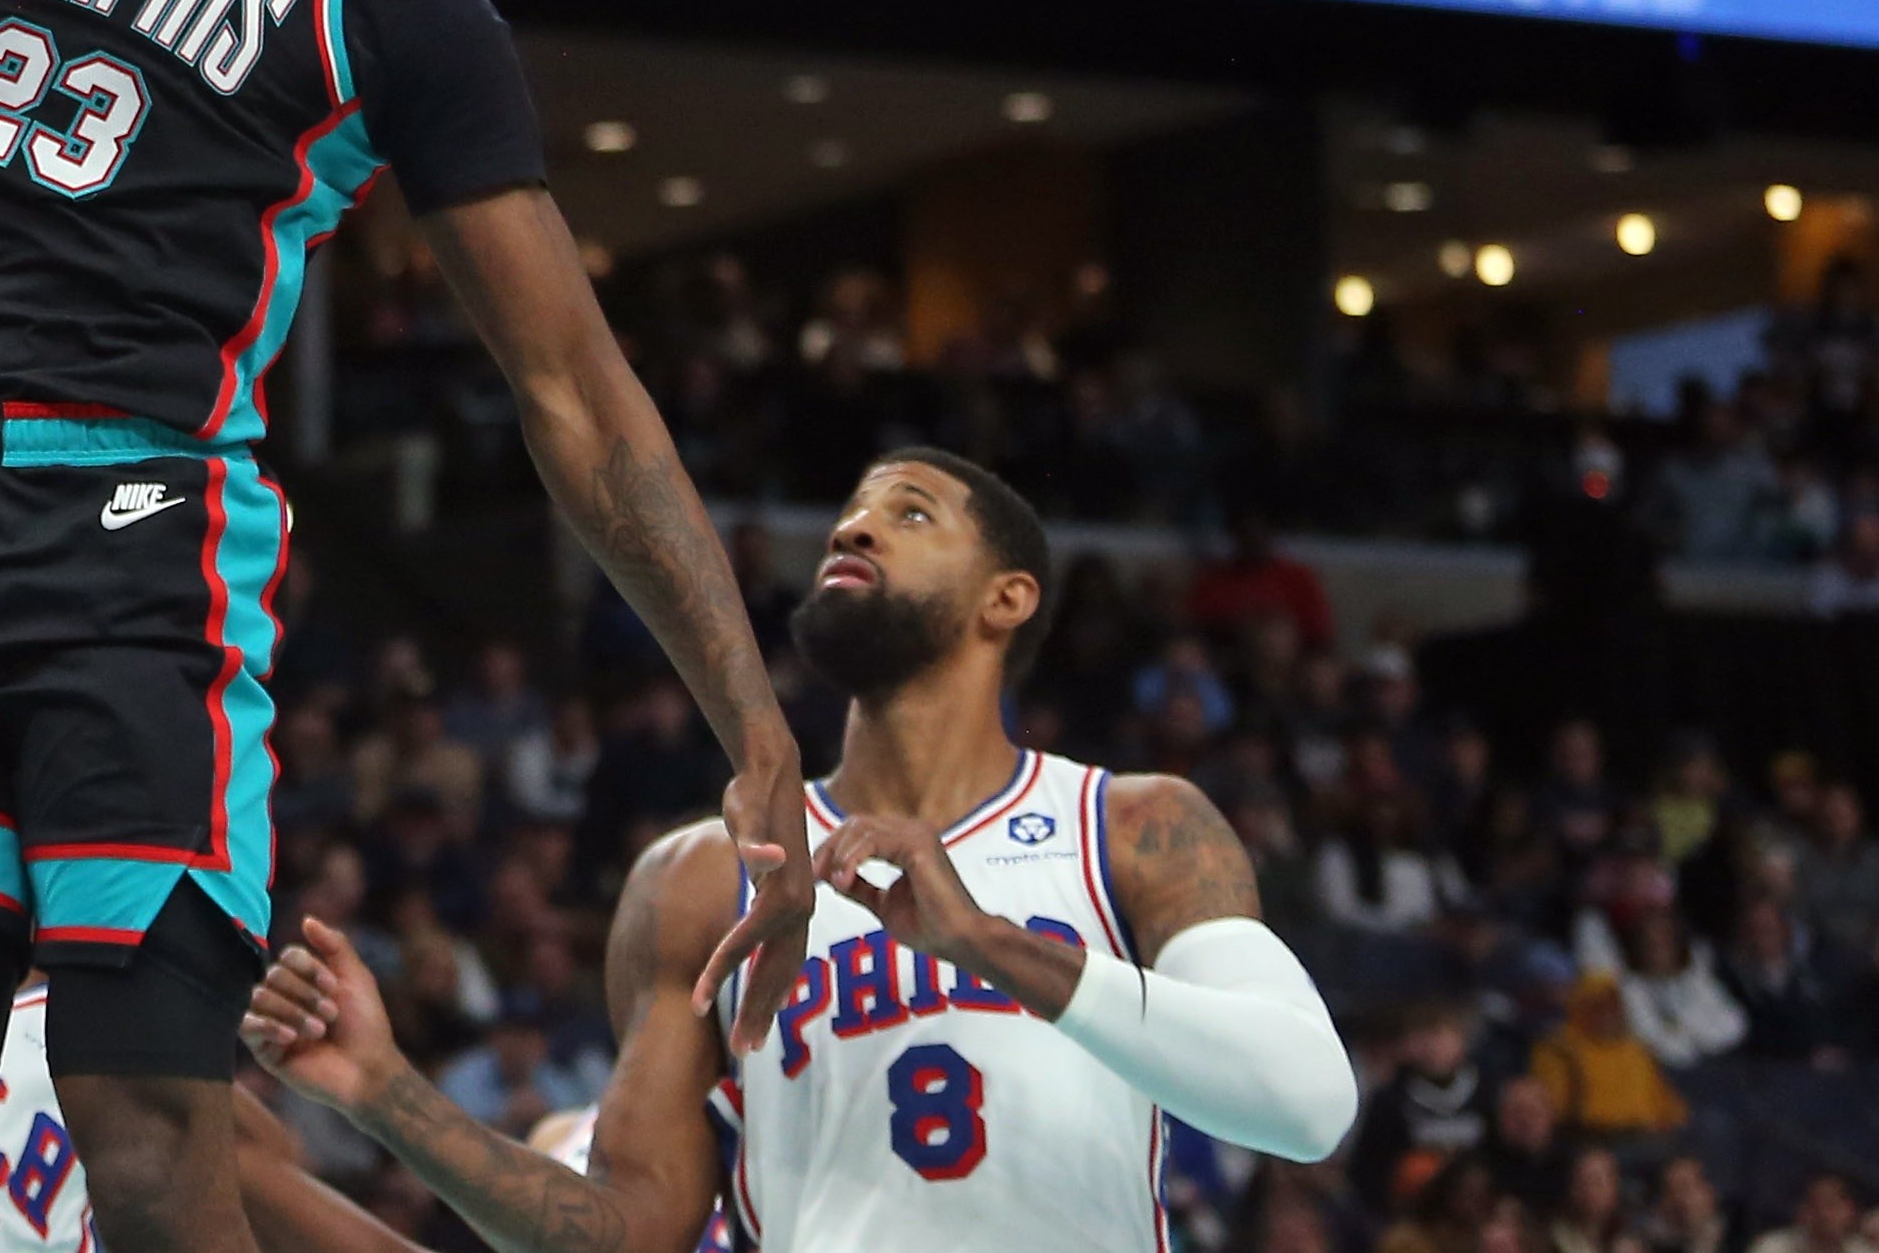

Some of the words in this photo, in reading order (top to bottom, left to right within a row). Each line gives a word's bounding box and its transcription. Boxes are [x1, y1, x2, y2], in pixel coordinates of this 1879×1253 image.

[111, 483, 167, 511] NIKE
[986, 851, 1078, 867] crypto.com
[887, 1044, 987, 1182] 8
